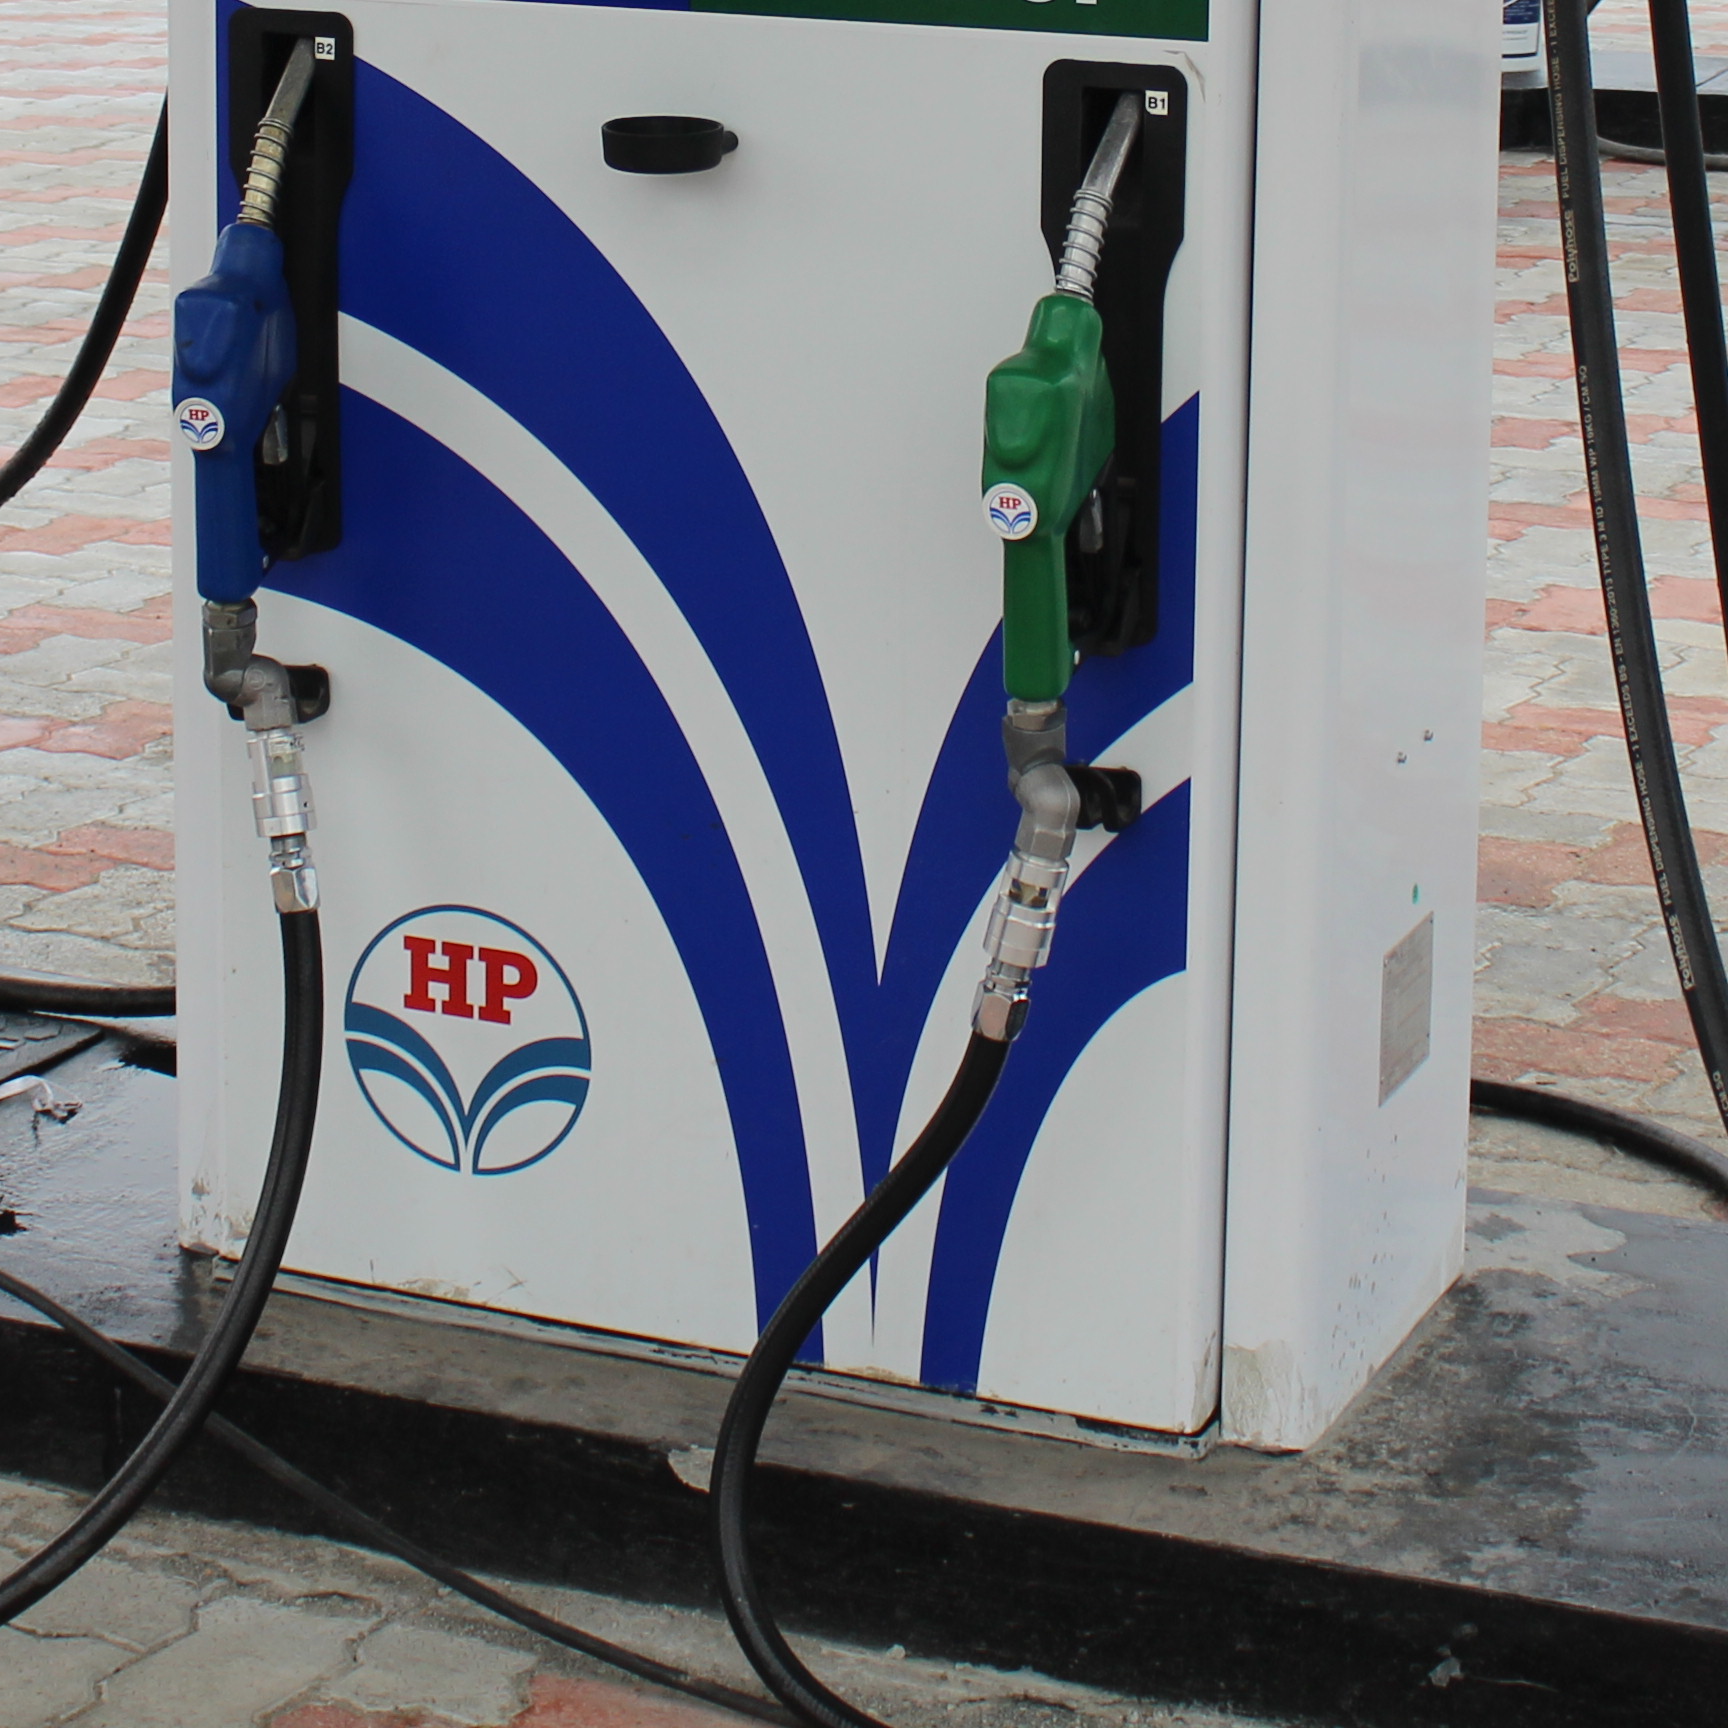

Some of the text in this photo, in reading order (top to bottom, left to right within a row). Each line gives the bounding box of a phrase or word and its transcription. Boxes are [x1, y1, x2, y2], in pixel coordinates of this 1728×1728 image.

[316, 42, 333, 56] B2
[1147, 95, 1166, 110] B1
[1578, 364, 1591, 404] CM.SQ
[188, 408, 209, 421] HP
[1583, 413, 1595, 444] 16KG
[1587, 447, 1598, 467] WP
[999, 496, 1022, 510] HP
[1599, 543, 1612, 574] TYPE
[1612, 636, 1623, 655] EN
[1617, 663, 1628, 681] BS
[1619, 683, 1639, 741] EXCEEDS
[1633, 760, 1649, 795] HOSE
[1637, 796, 1667, 871] DISPENSING
[1655, 871, 1675, 905] FUEL
[1660, 913, 1699, 990] Polyhose
[403, 935, 538, 1025] HP
